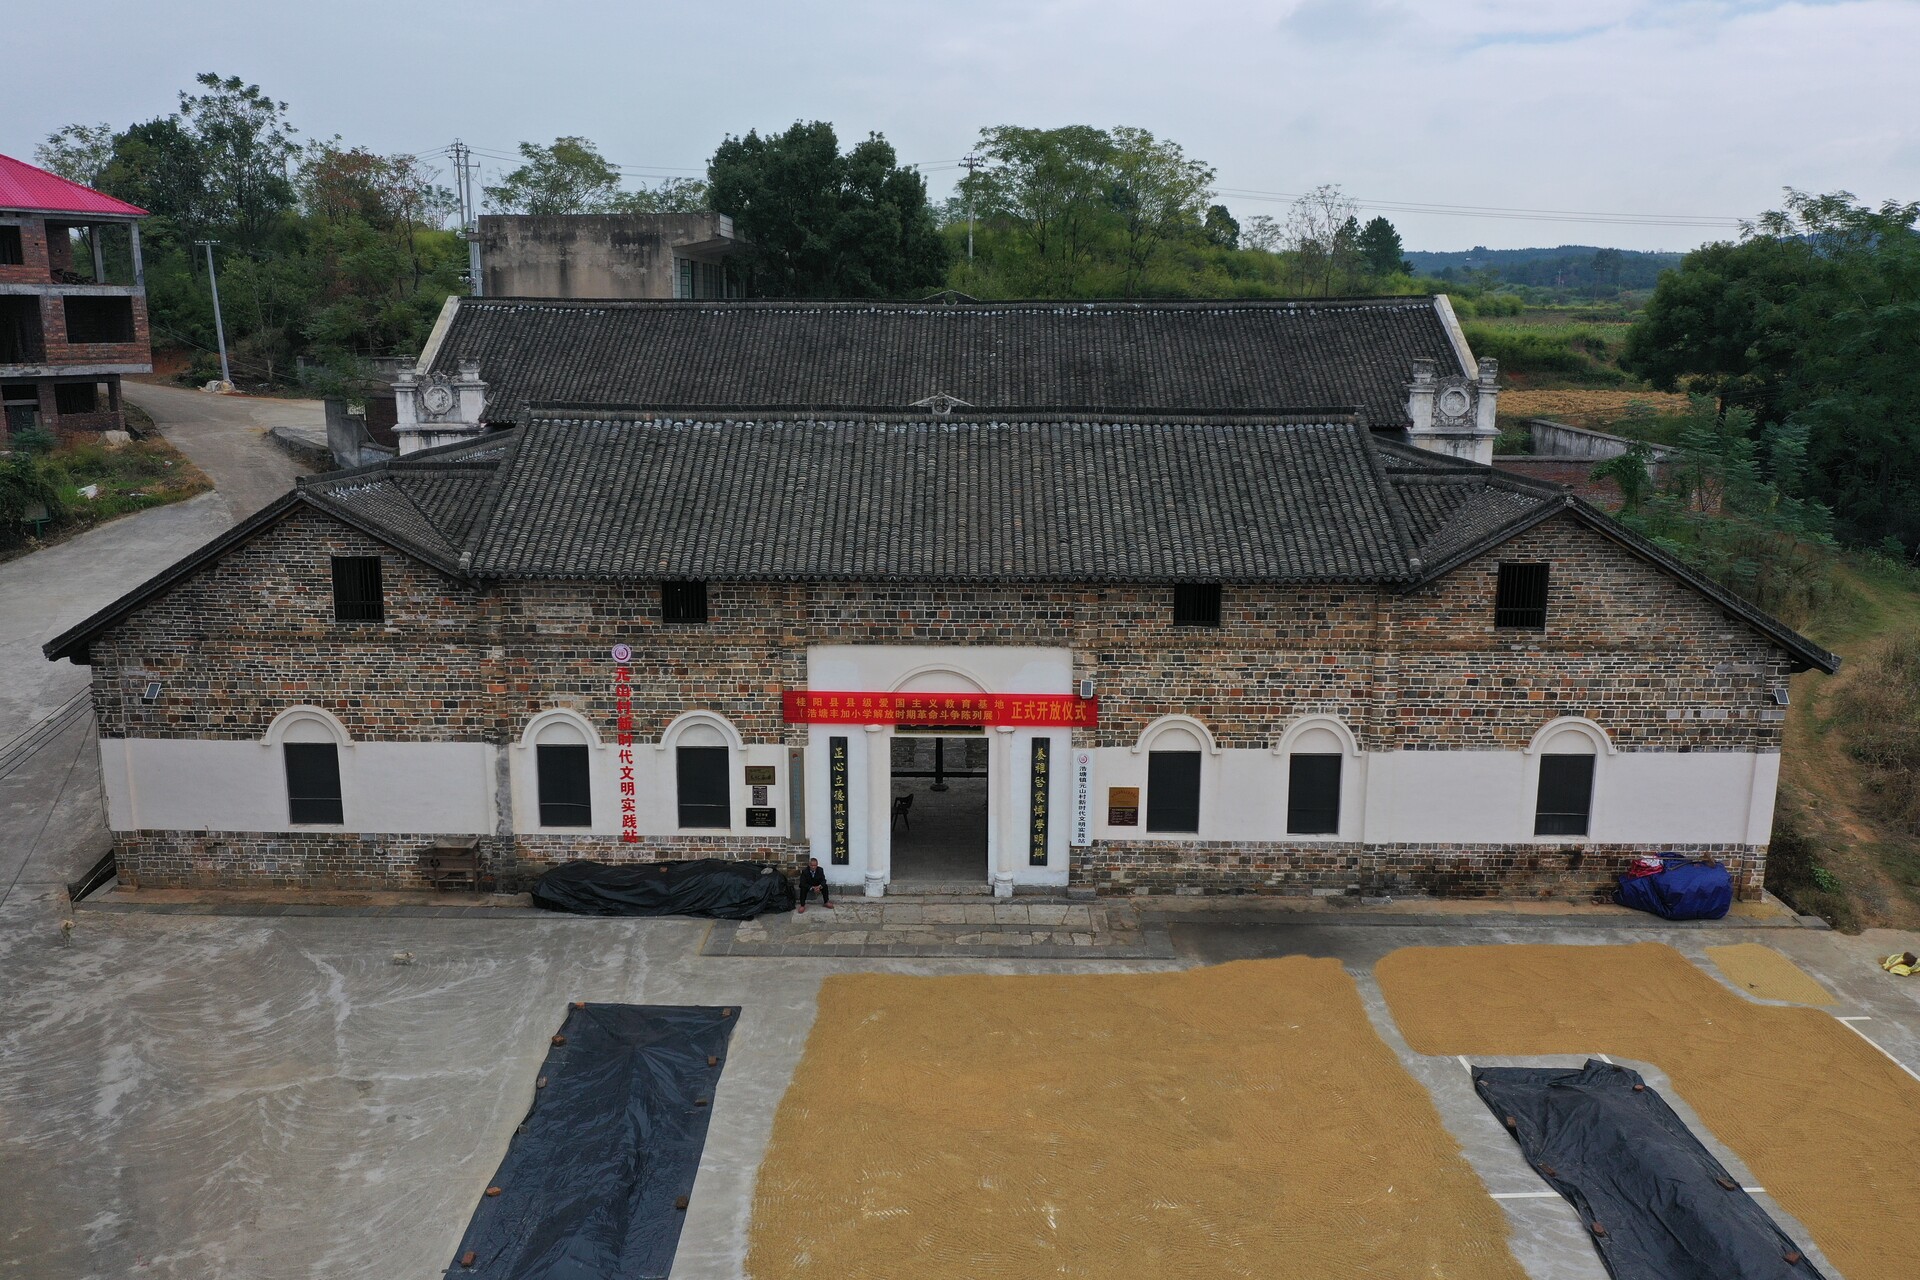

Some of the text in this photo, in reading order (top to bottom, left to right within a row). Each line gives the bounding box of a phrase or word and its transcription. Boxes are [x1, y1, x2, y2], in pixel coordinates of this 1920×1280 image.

[795, 696, 1005, 710] 桂阳县县级爱国主义教育基地
[1011, 700, 1087, 721] 正式开放仪式
[615, 667, 638, 843] 元山村新时代文明实践站
[1078, 766, 1087, 844] 浩塘镇元山村新时代文明实践站
